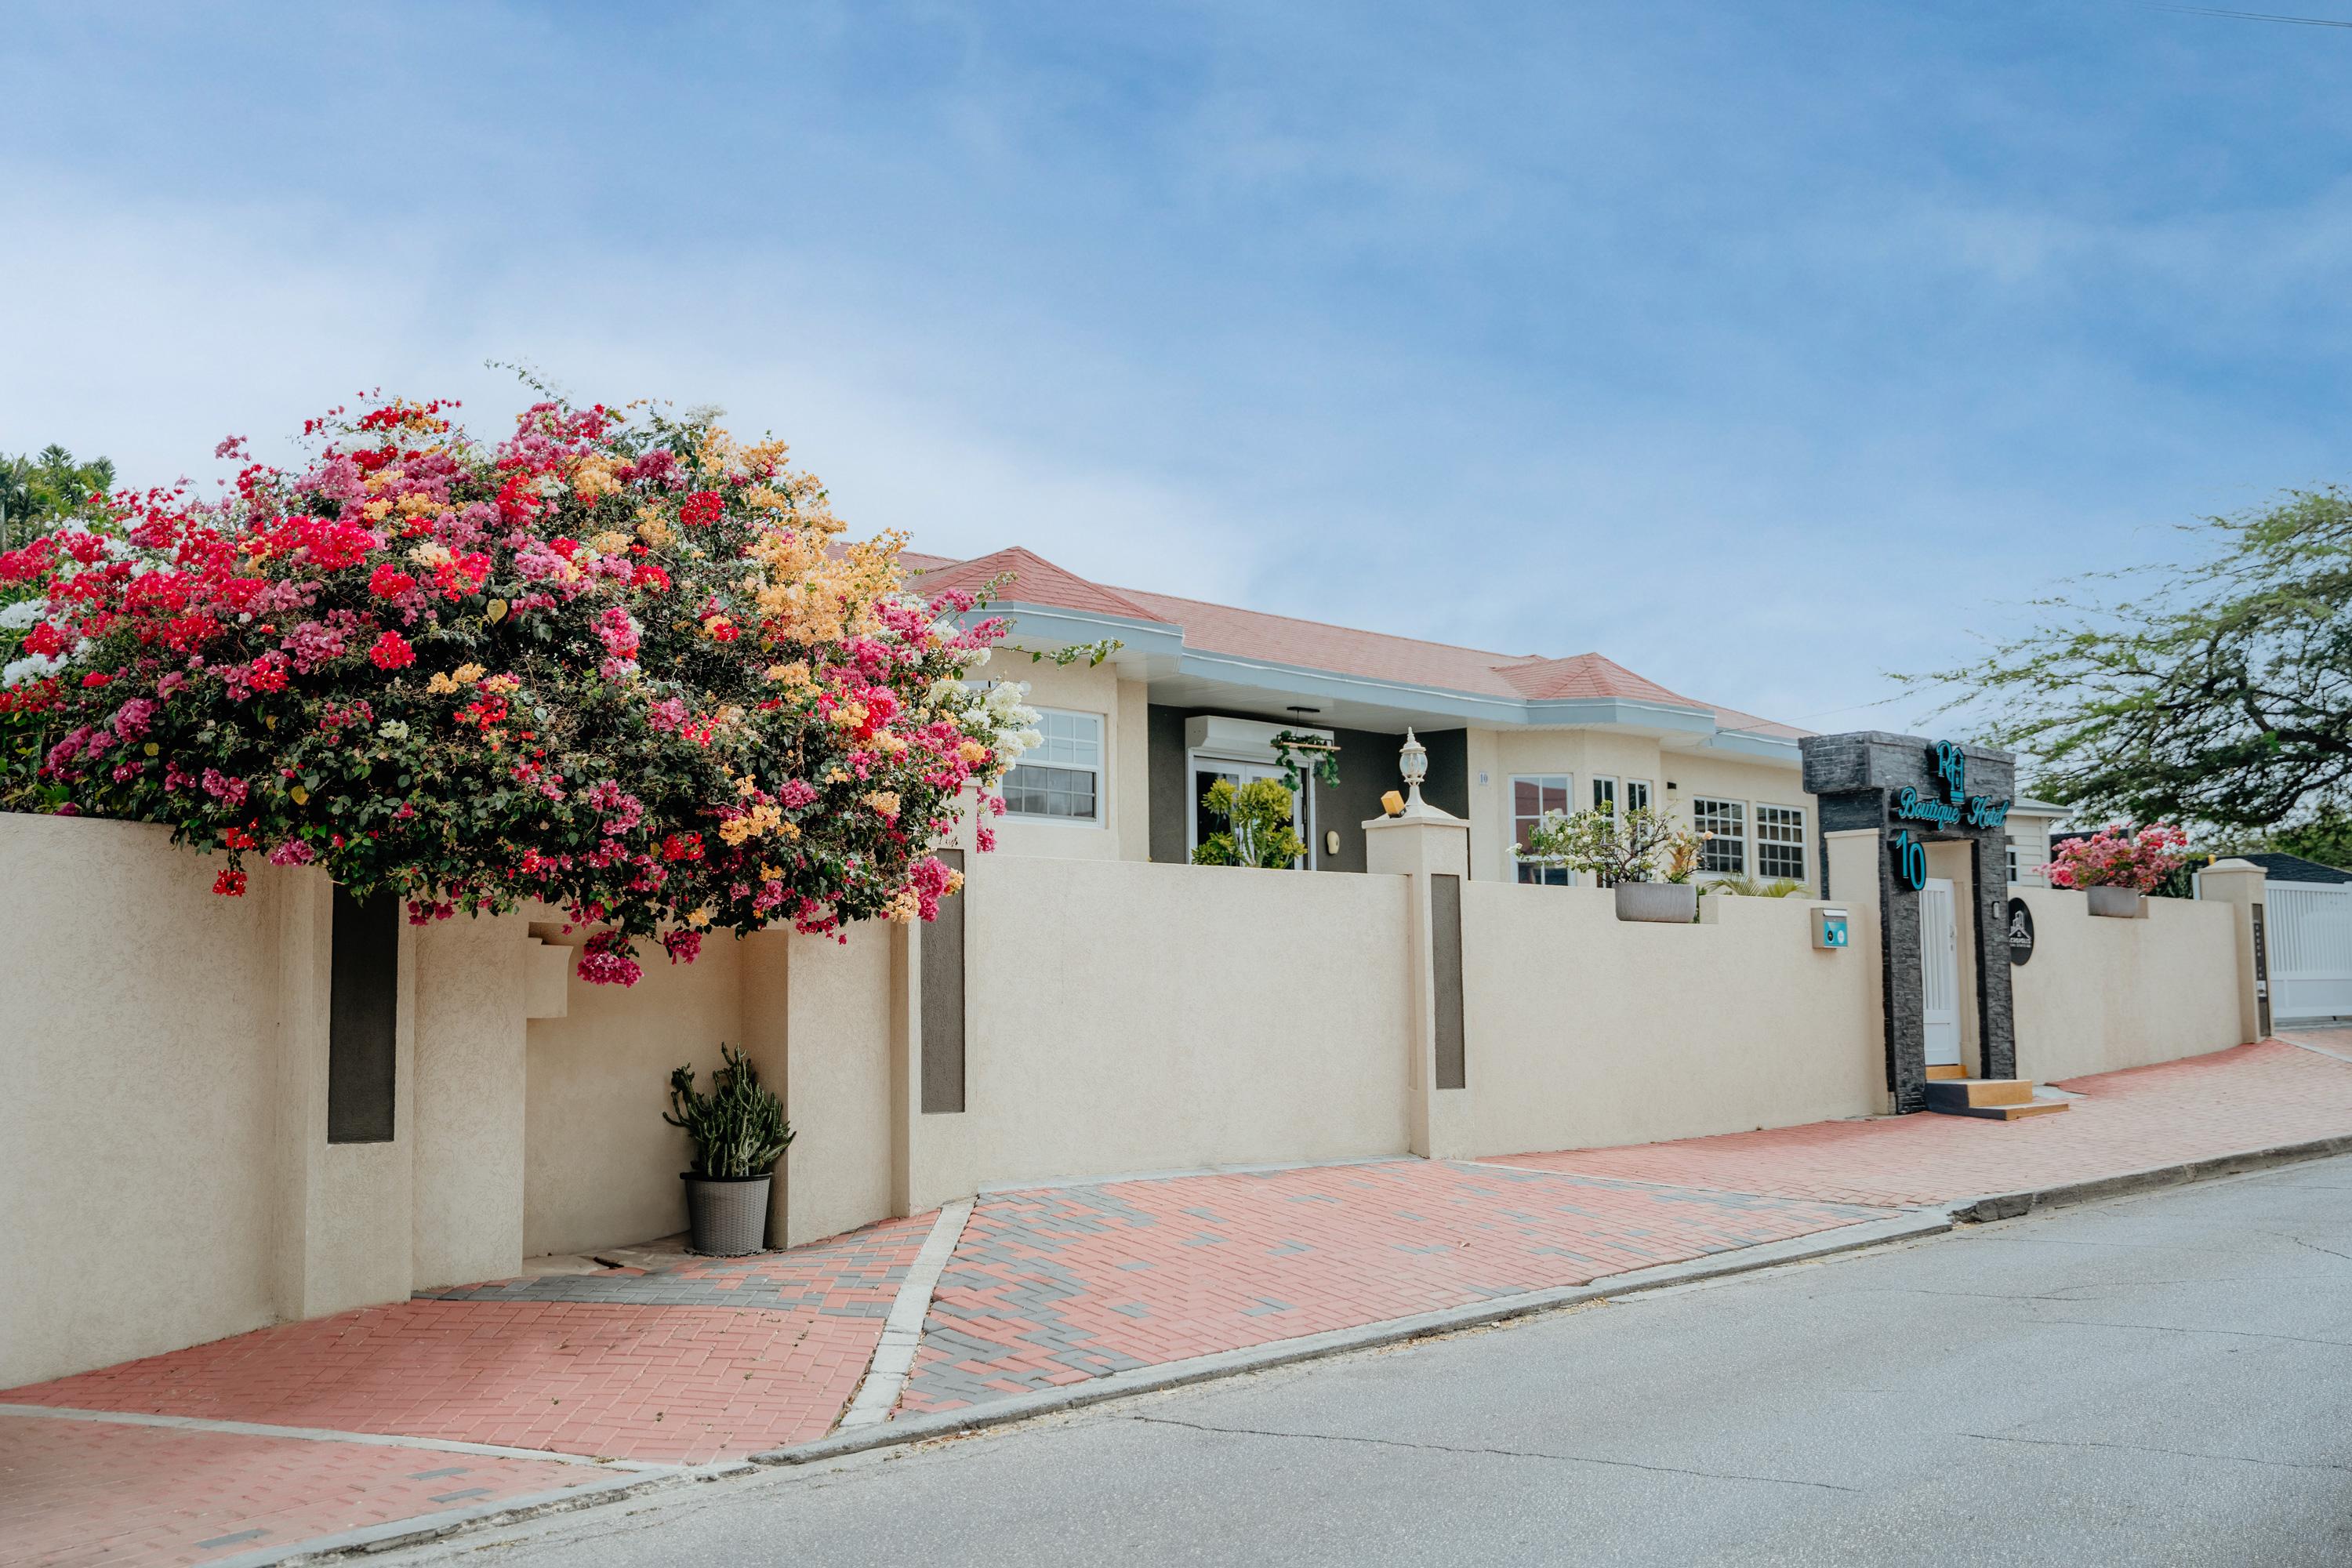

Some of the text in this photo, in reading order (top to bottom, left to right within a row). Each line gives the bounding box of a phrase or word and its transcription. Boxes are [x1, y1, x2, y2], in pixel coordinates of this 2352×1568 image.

[1480, 773, 1488, 783] 10
[1898, 786, 2010, 831] Boutique Hotel
[1896, 830, 1926, 891] 10
